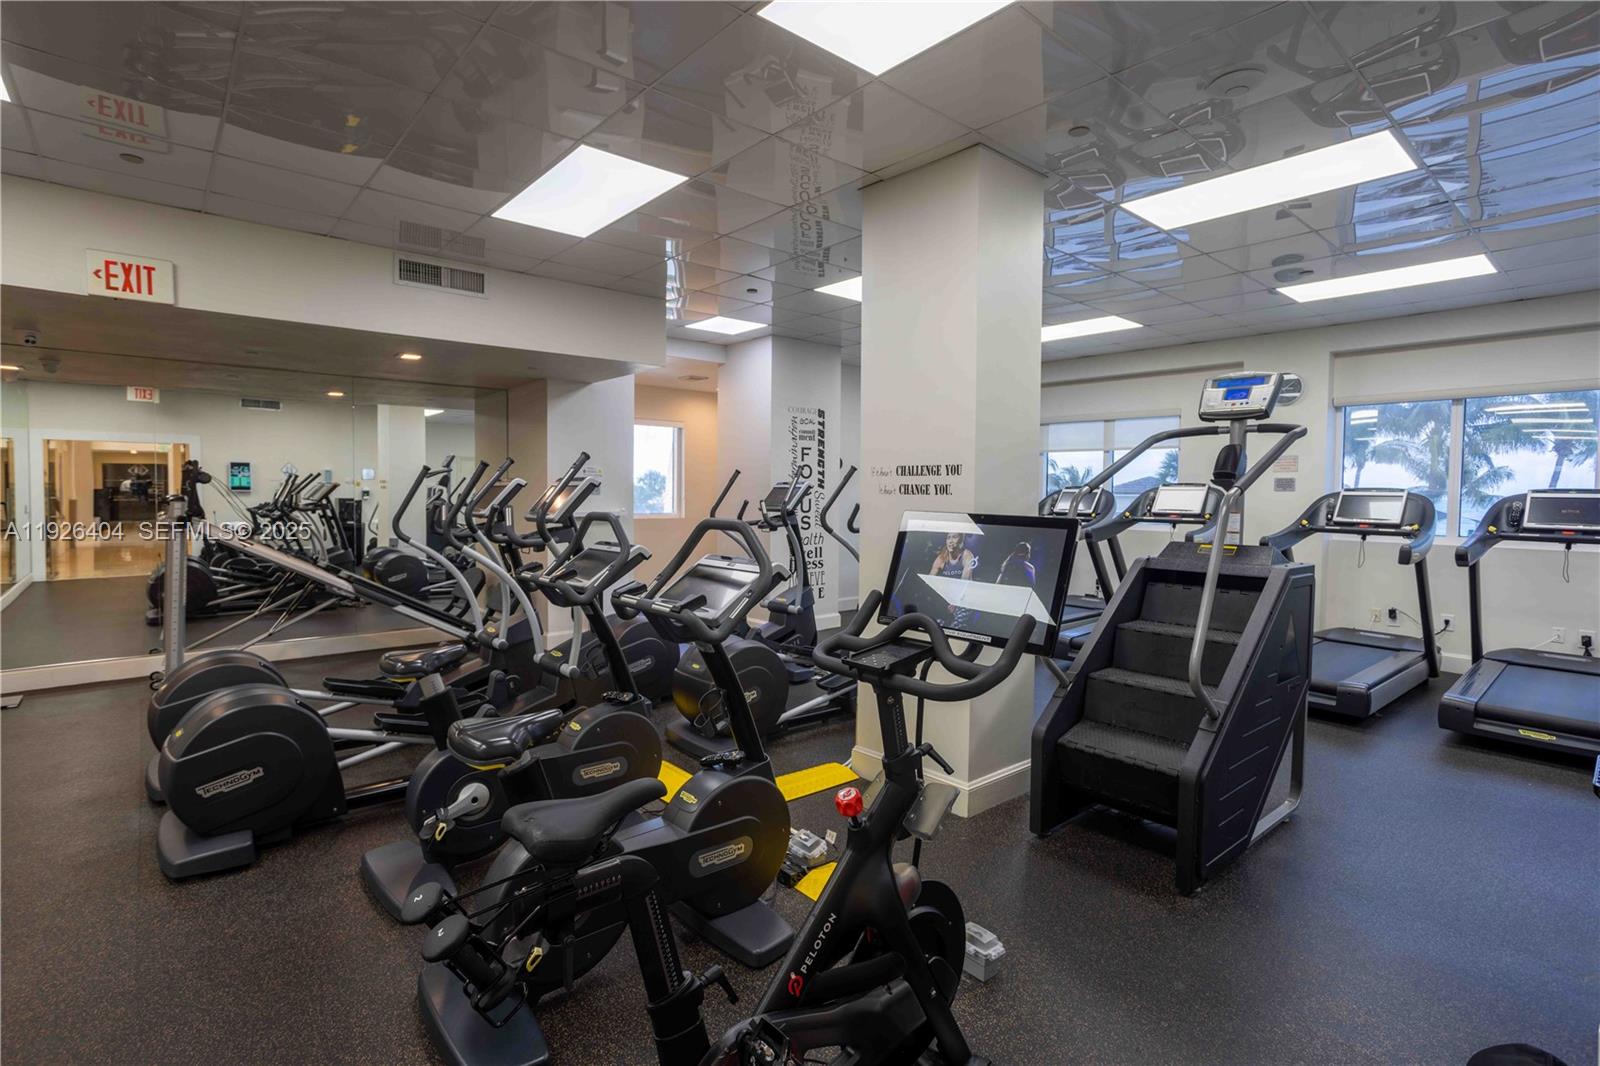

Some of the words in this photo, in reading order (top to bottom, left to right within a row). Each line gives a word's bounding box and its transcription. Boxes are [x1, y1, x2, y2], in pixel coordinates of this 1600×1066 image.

[104, 260, 156, 296] EXIT
[817, 408, 826, 490] STRENGTH
[896, 465, 941, 477] CHALLENGE
[945, 464, 963, 476] YOU
[899, 484, 930, 496] CHANGE
[934, 484, 953, 496] YOU.
[698, 842, 745, 868] TECHNOGYM
[800, 912, 838, 974] PELOTON
